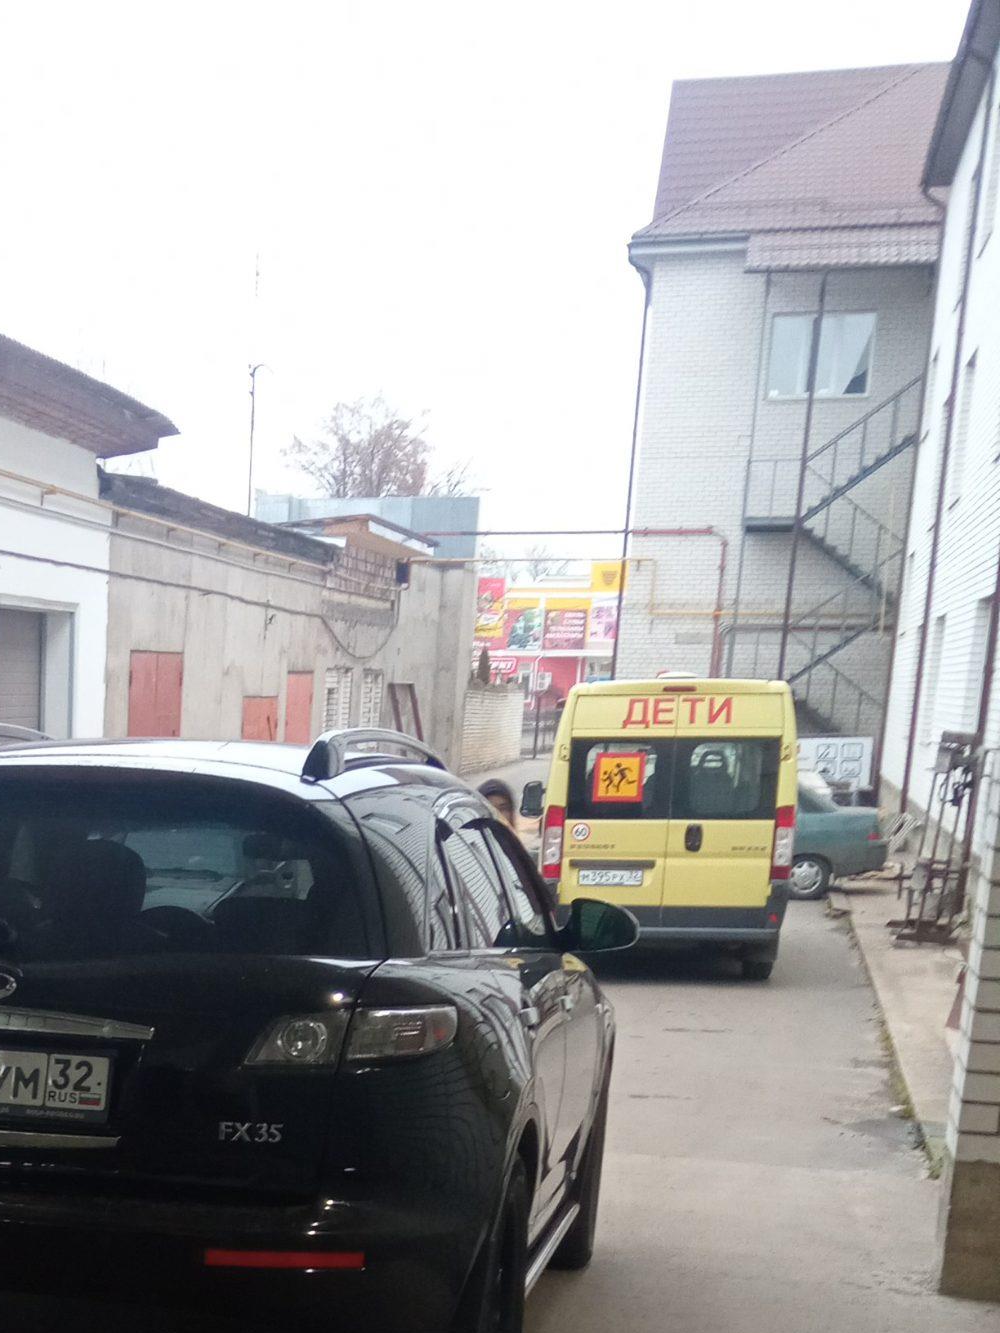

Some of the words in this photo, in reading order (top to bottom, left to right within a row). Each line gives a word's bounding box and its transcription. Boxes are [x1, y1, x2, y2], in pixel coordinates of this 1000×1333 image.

[622, 697, 733, 728] ДЕТИ
[51, 1058, 94, 1092] 32
[48, 1090, 79, 1104] RUS
